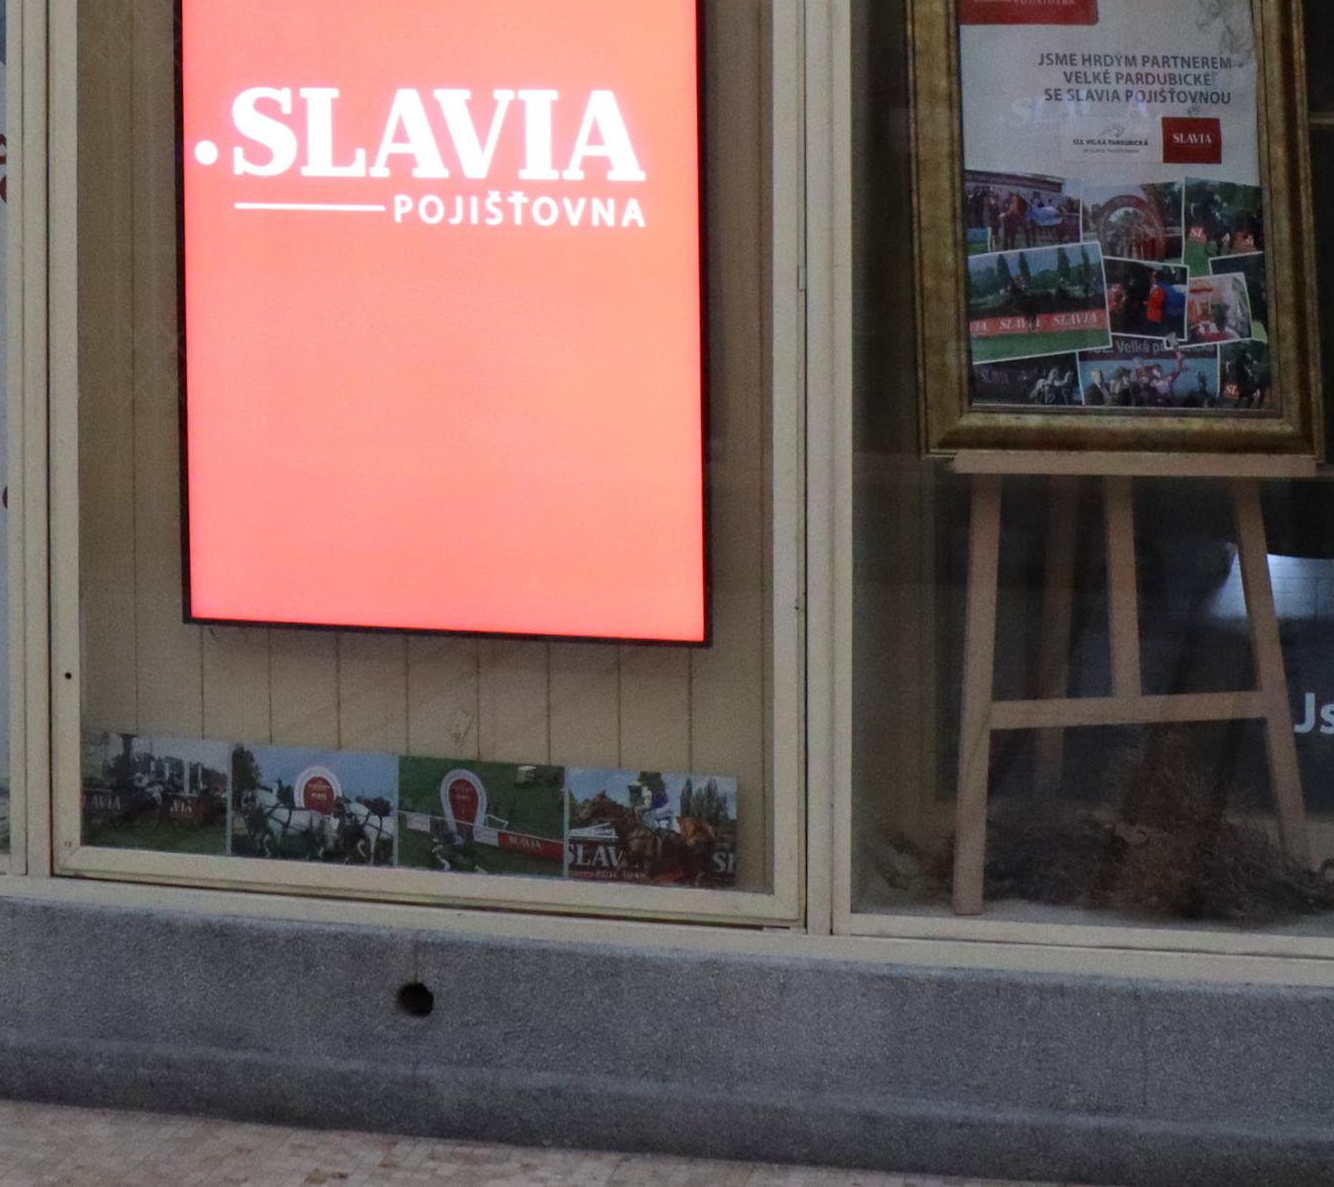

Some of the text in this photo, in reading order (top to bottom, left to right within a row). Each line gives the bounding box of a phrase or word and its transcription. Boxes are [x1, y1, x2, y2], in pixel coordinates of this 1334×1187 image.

[1038, 53, 1078, 66] JSME
[1142, 55, 1233, 70] PARTNEREM
[1063, 69, 1212, 86] VELKÉ PARDUBICKÉ
[1044, 88, 1231, 105] SE SLAVIA POJIŠŤOVNOU
[231, 86, 646, 181] SLAVIA
[1173, 133, 1212, 144] SLAVIA
[393, 190, 646, 228] POJIŠŤOVNA
[1052, 312, 1098, 326] SLAVIA
